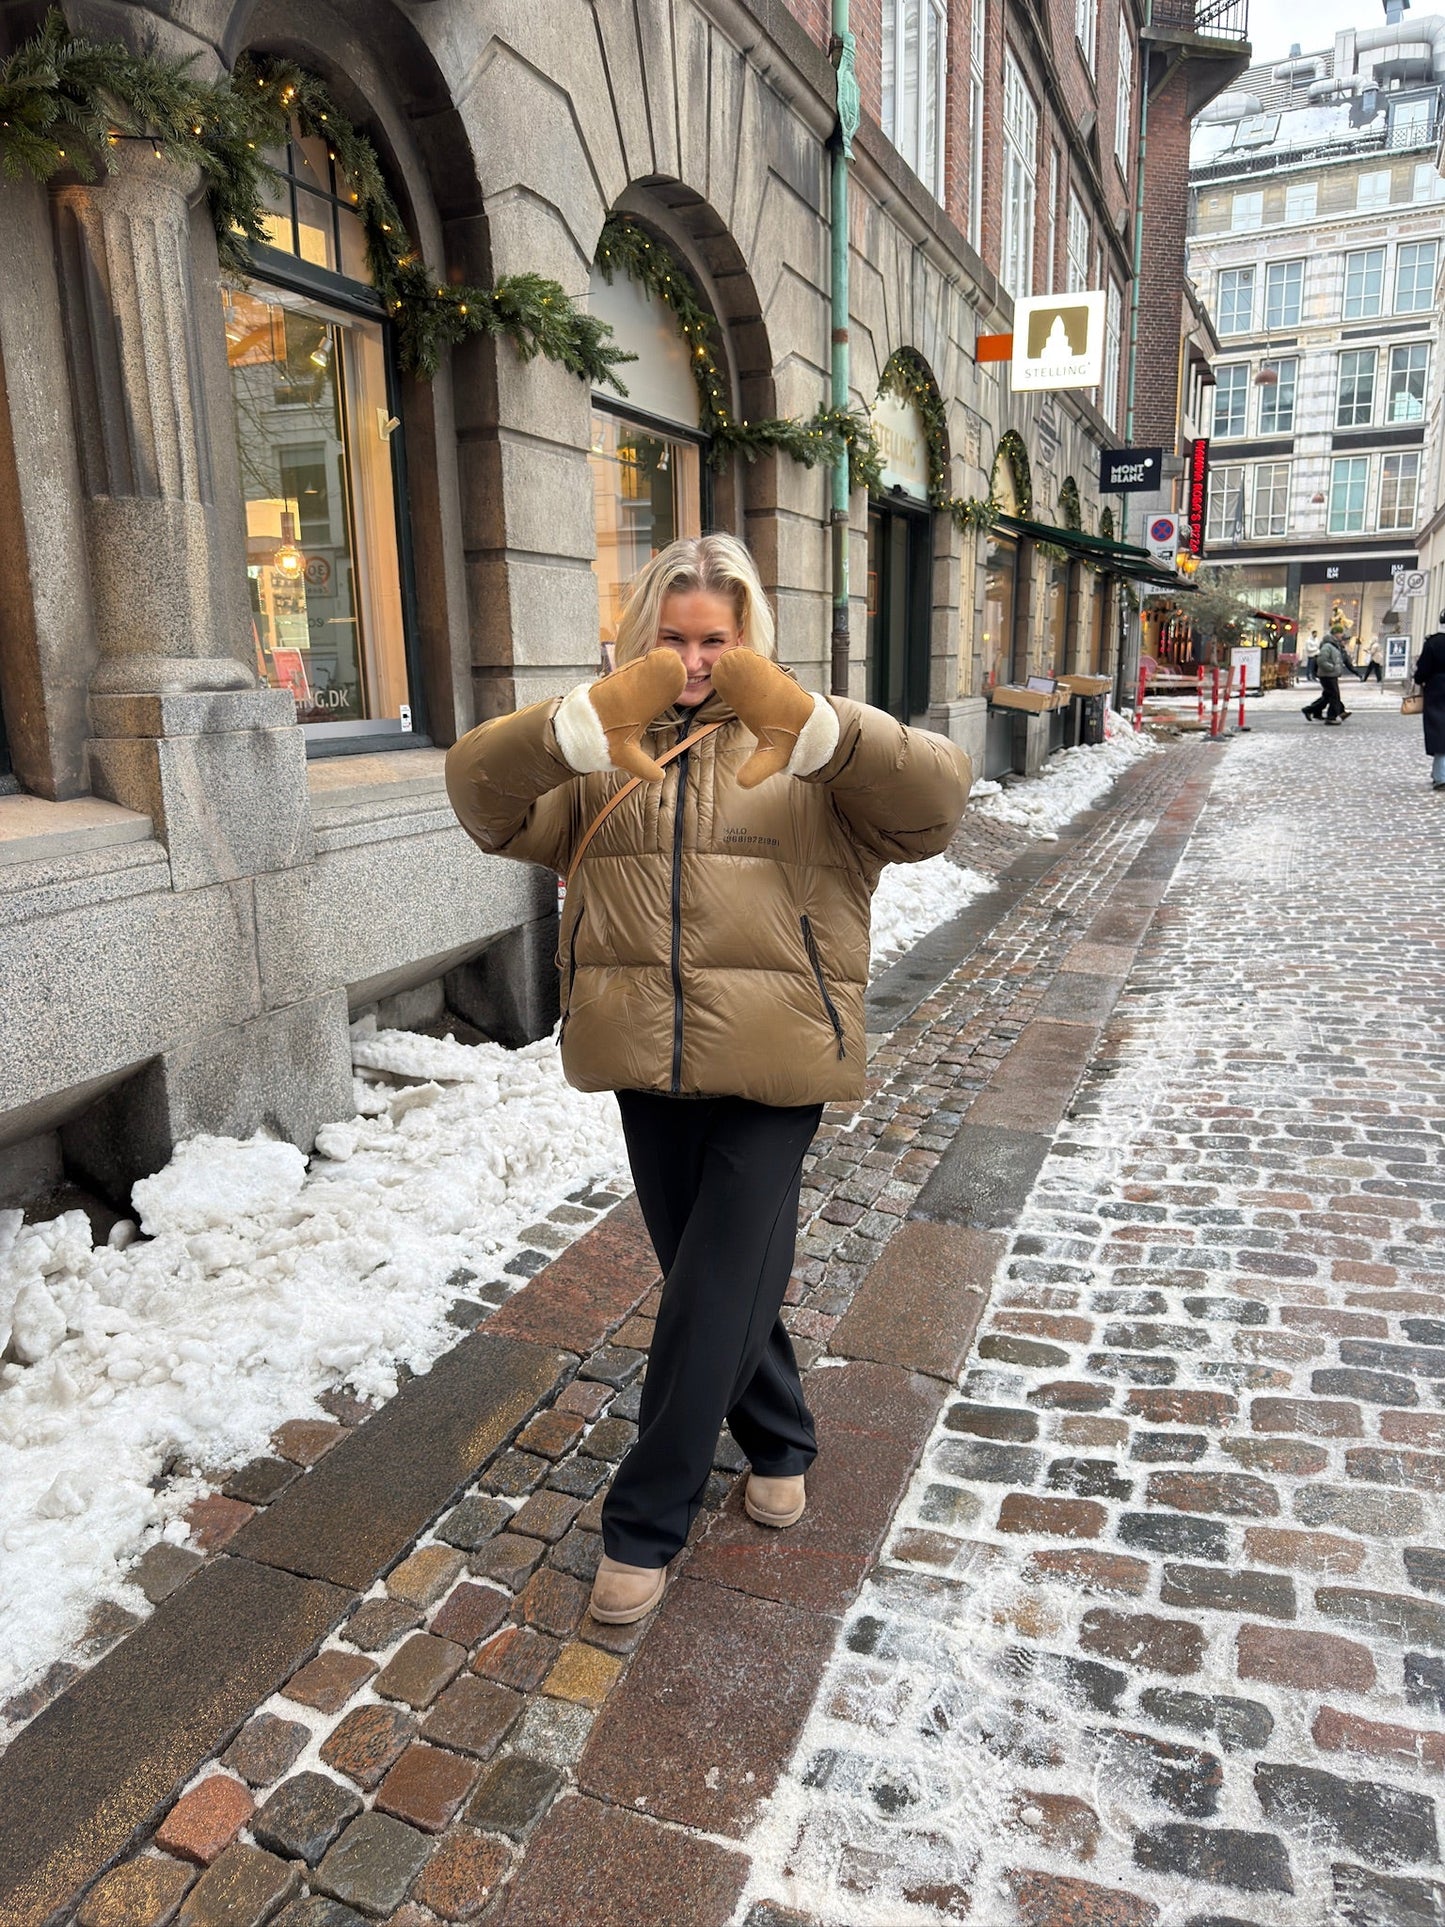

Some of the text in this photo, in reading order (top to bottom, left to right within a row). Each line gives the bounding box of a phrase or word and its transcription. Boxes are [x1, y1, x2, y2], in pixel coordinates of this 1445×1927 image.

[1024, 364, 1087, 379] STELLING
[1110, 463, 1144, 474] MONT
[1110, 472, 1144, 483] BLANC
[1190, 440, 1206, 553] MAMMA ROSA'S PIZZA
